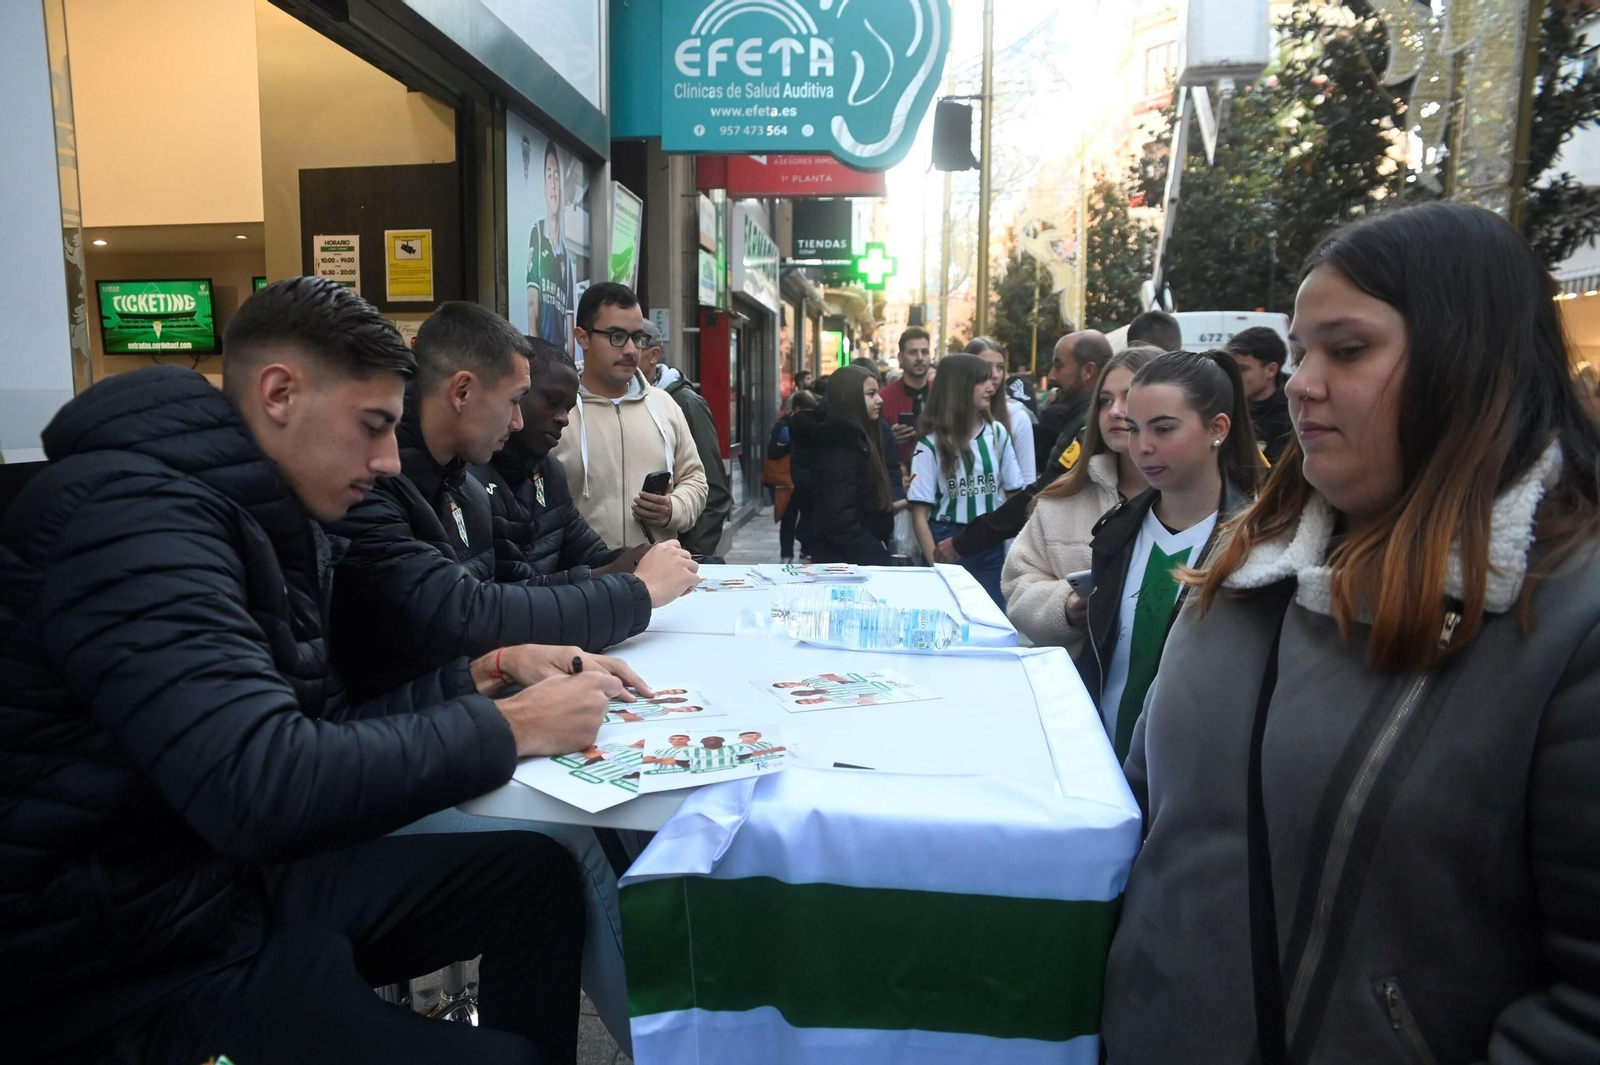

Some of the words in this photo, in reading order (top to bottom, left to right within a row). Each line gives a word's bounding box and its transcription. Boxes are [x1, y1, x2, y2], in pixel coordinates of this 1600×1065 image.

[674, 37, 835, 77] EFETA
[674, 83, 724, 99] Clínicas
[726, 83, 742, 99] de
[745, 83, 780, 99] Salud
[783, 83, 834, 99] Auditiva
[710, 104, 797, 119] www.efeta.es
[719, 125, 740, 137] 957
[743, 125, 764, 137] 473
[766, 125, 788, 137] 564
[773, 157, 813, 165] ASESORES
[792, 174, 832, 183] PLANTA
[797, 239, 847, 249] TIENDAS
[112, 293, 196, 313] TICKETING
